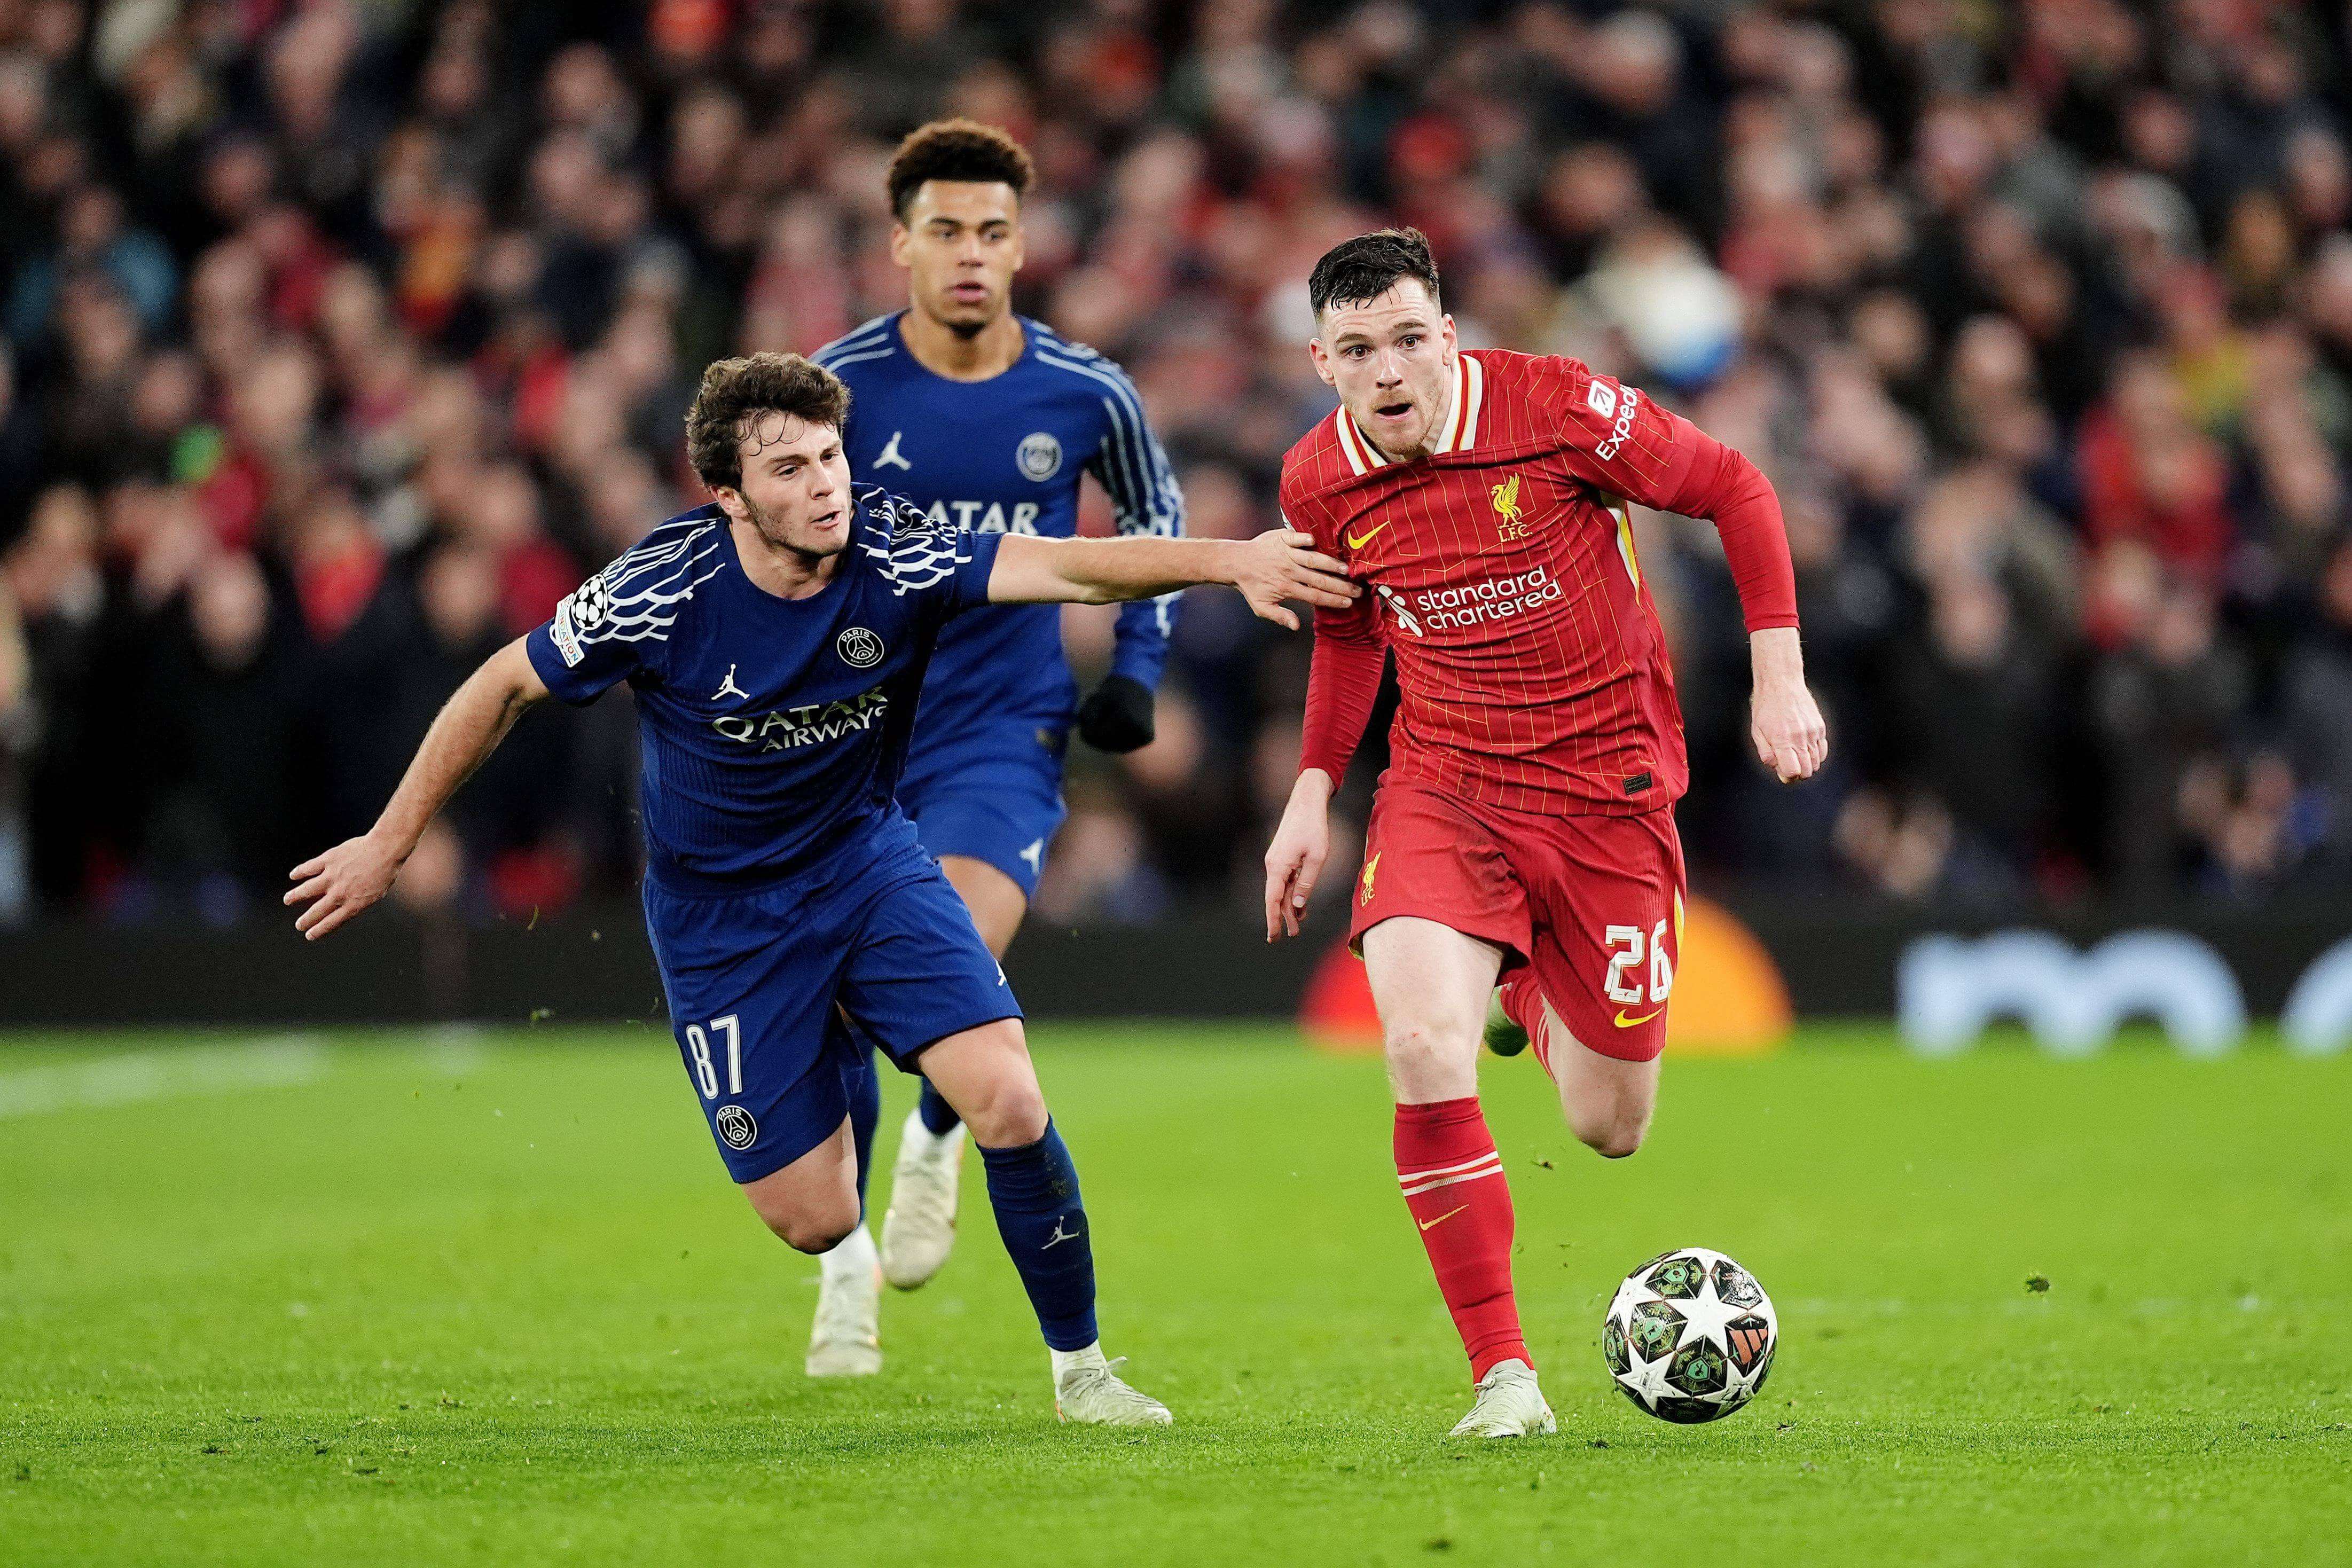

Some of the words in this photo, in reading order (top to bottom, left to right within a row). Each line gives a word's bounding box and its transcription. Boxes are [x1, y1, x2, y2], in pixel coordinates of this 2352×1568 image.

[1595, 384, 1637, 461] Expedi
[928, 499, 1040, 536] ATAR
[1417, 565, 1547, 611] standard
[1426, 579, 1562, 629] chartered
[841, 630, 869, 642] PARIS
[1604, 918, 1674, 1005] 26
[686, 1014, 742, 1100] 87
[718, 1107, 741, 1122] PARIS
